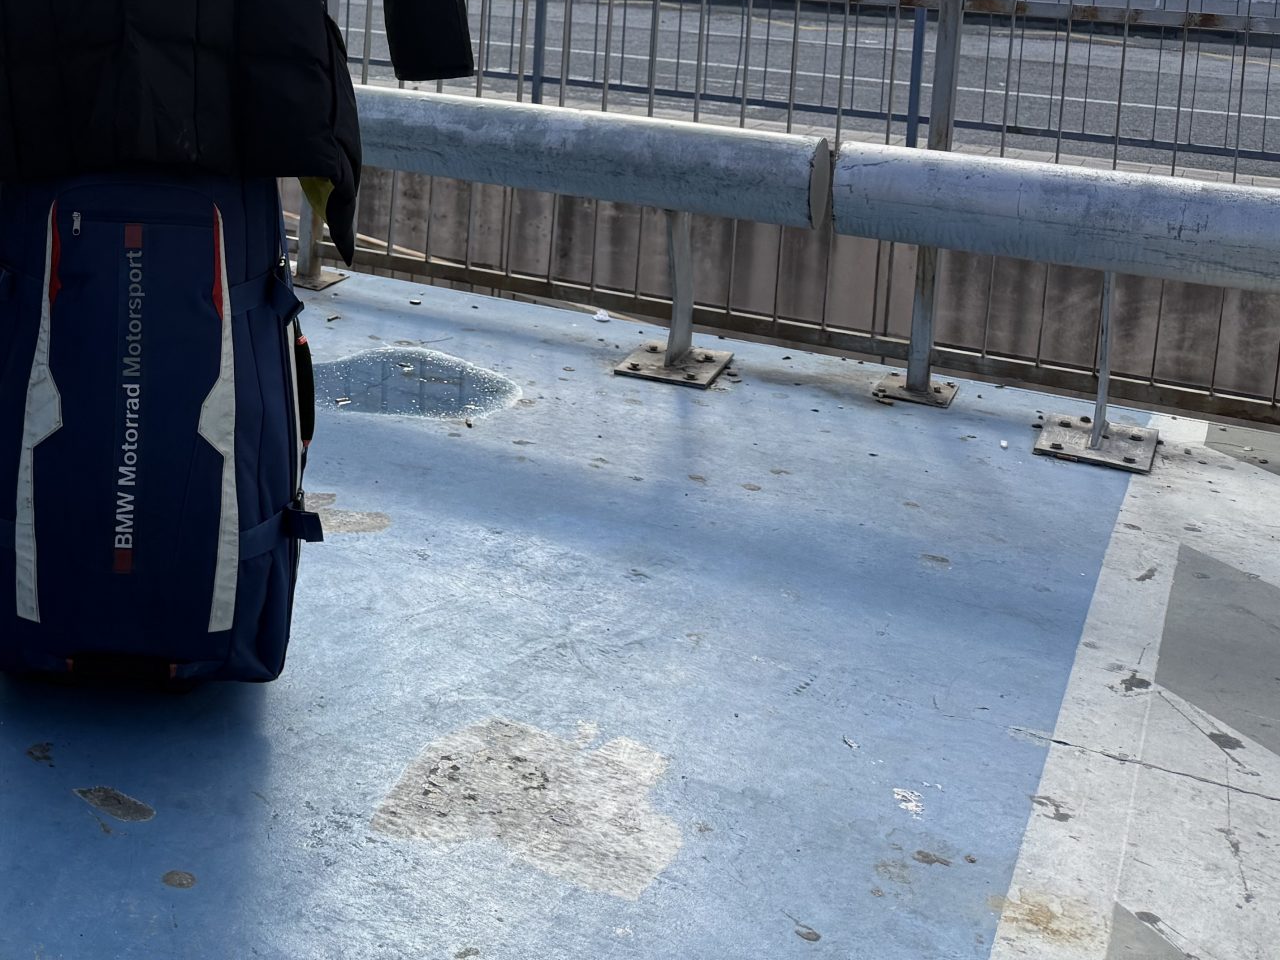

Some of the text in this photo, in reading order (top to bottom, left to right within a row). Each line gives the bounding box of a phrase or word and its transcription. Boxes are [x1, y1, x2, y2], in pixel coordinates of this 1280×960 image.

[115, 249, 145, 549] BMW Motorrad Motorsport
